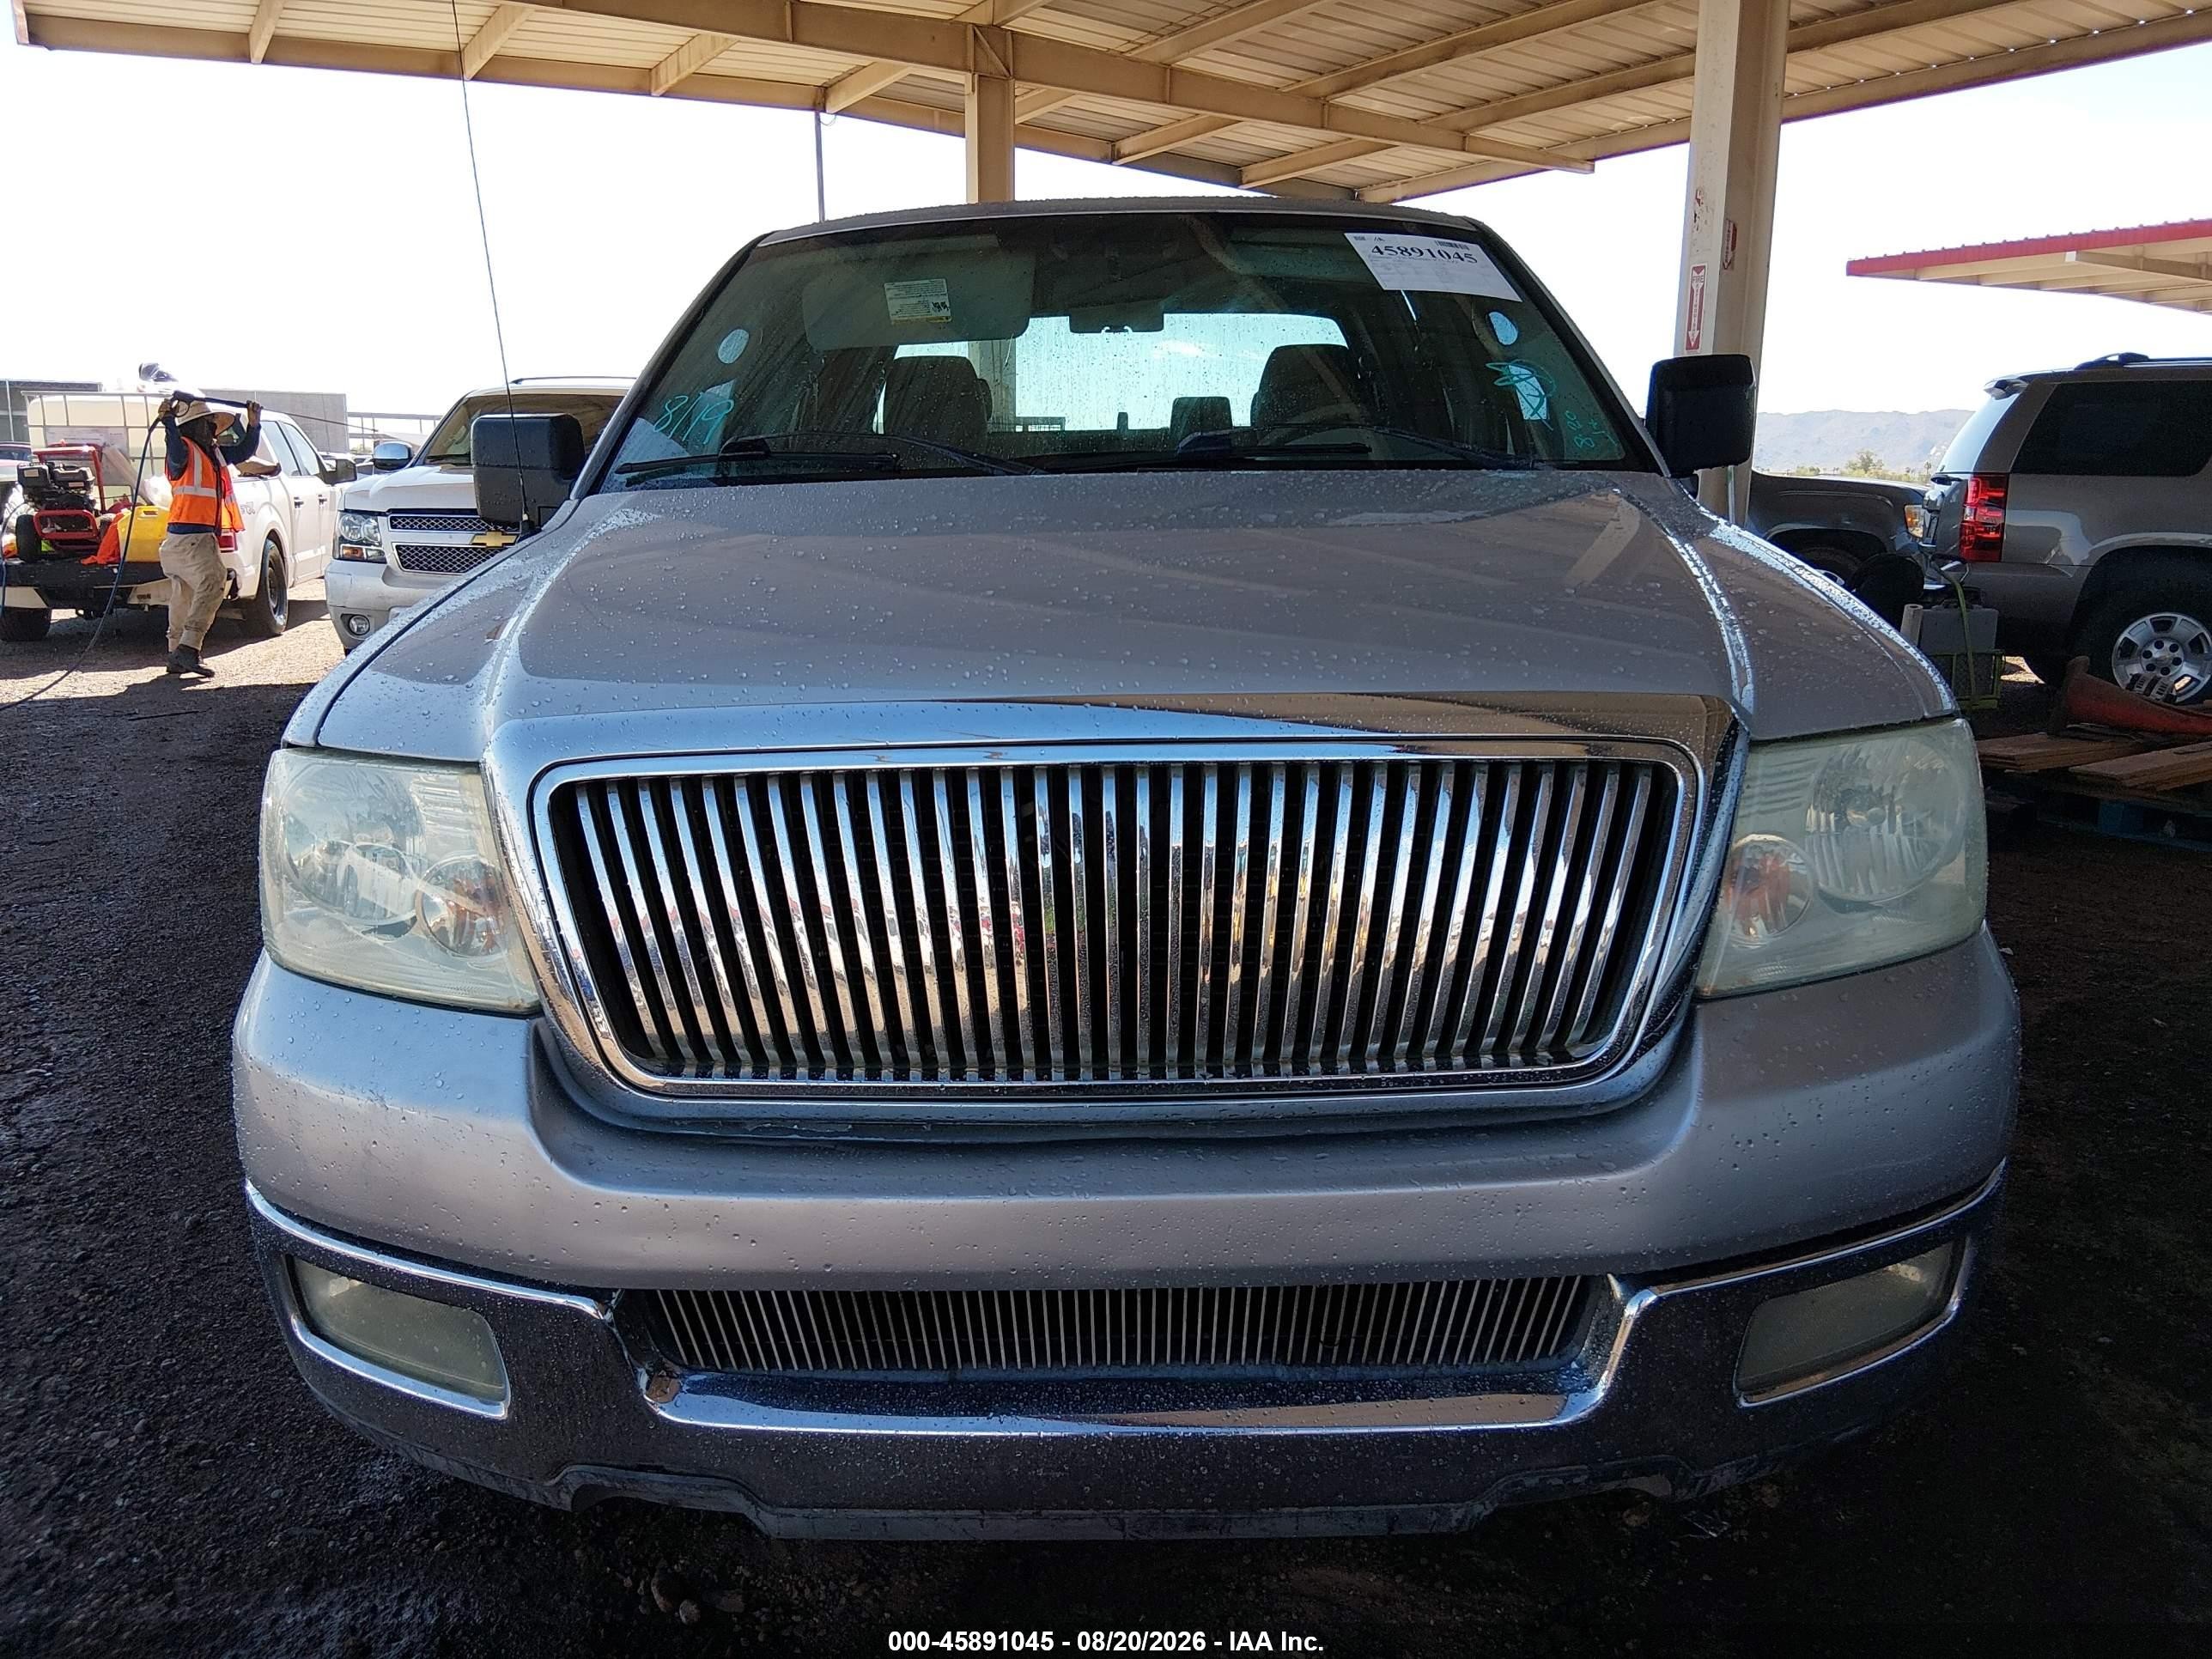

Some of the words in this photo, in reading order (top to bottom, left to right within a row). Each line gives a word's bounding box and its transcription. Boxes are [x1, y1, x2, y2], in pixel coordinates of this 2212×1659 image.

[1371, 245, 1478, 264] 45891045
[1692, 275, 1705, 283] FIRE
[653, 391, 734, 445] 8/19
